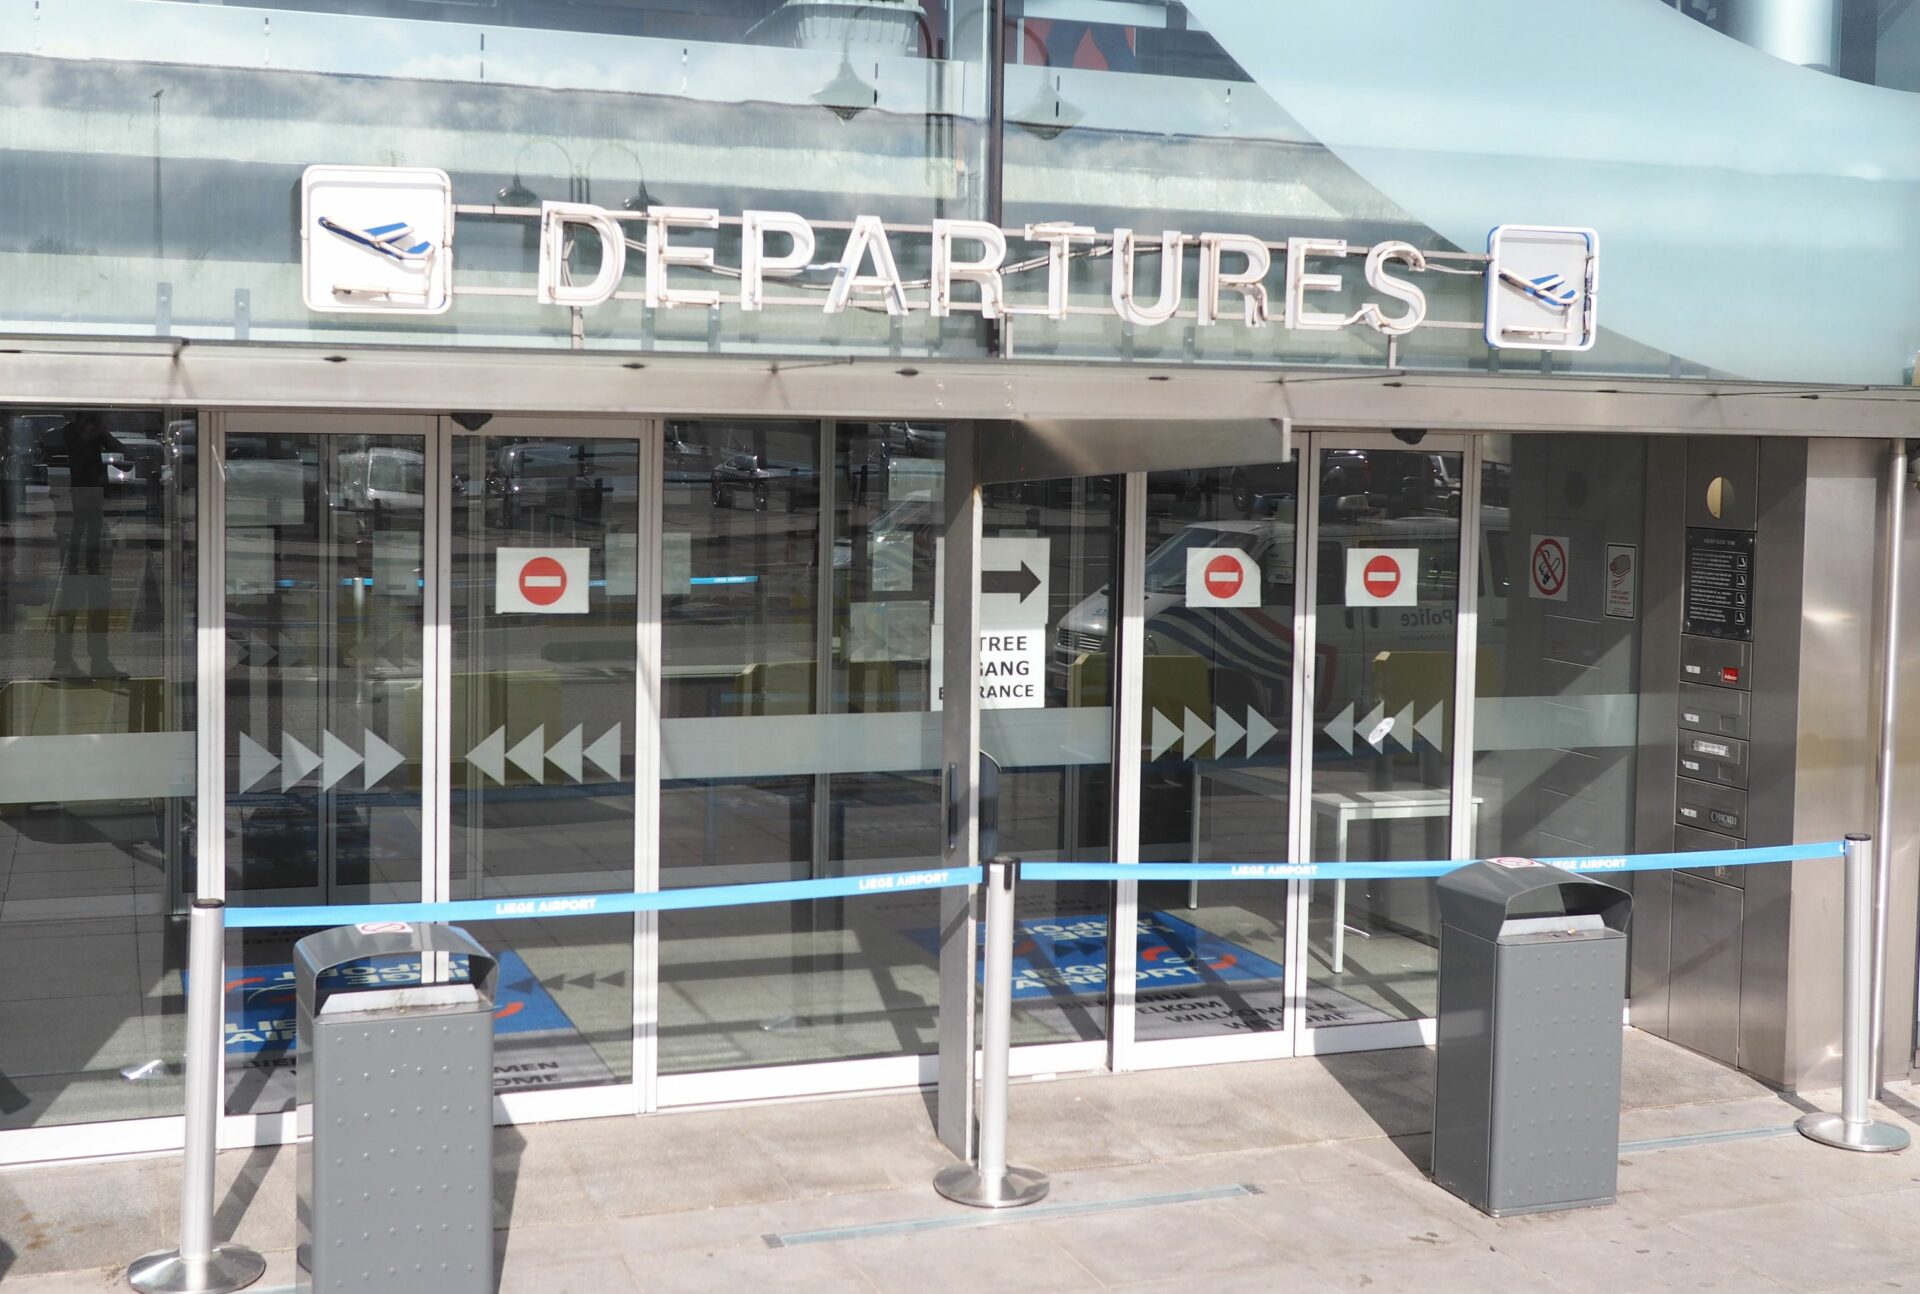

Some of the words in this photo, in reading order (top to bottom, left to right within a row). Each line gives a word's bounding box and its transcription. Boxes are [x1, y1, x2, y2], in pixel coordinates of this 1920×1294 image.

[537, 200, 1428, 335] DEPARTURES
[1231, 865, 1264, 876] LIEGE
[1267, 864, 1318, 875] AIRPORT
[1580, 858, 1626, 869] AIRPORT
[859, 876, 894, 890] LIEGE
[896, 872, 948, 886] AIRPORT
[496, 901, 535, 915] LIEGE
[538, 898, 596, 912] AIRPORT
[1136, 1000, 1222, 1014] ELKOM
